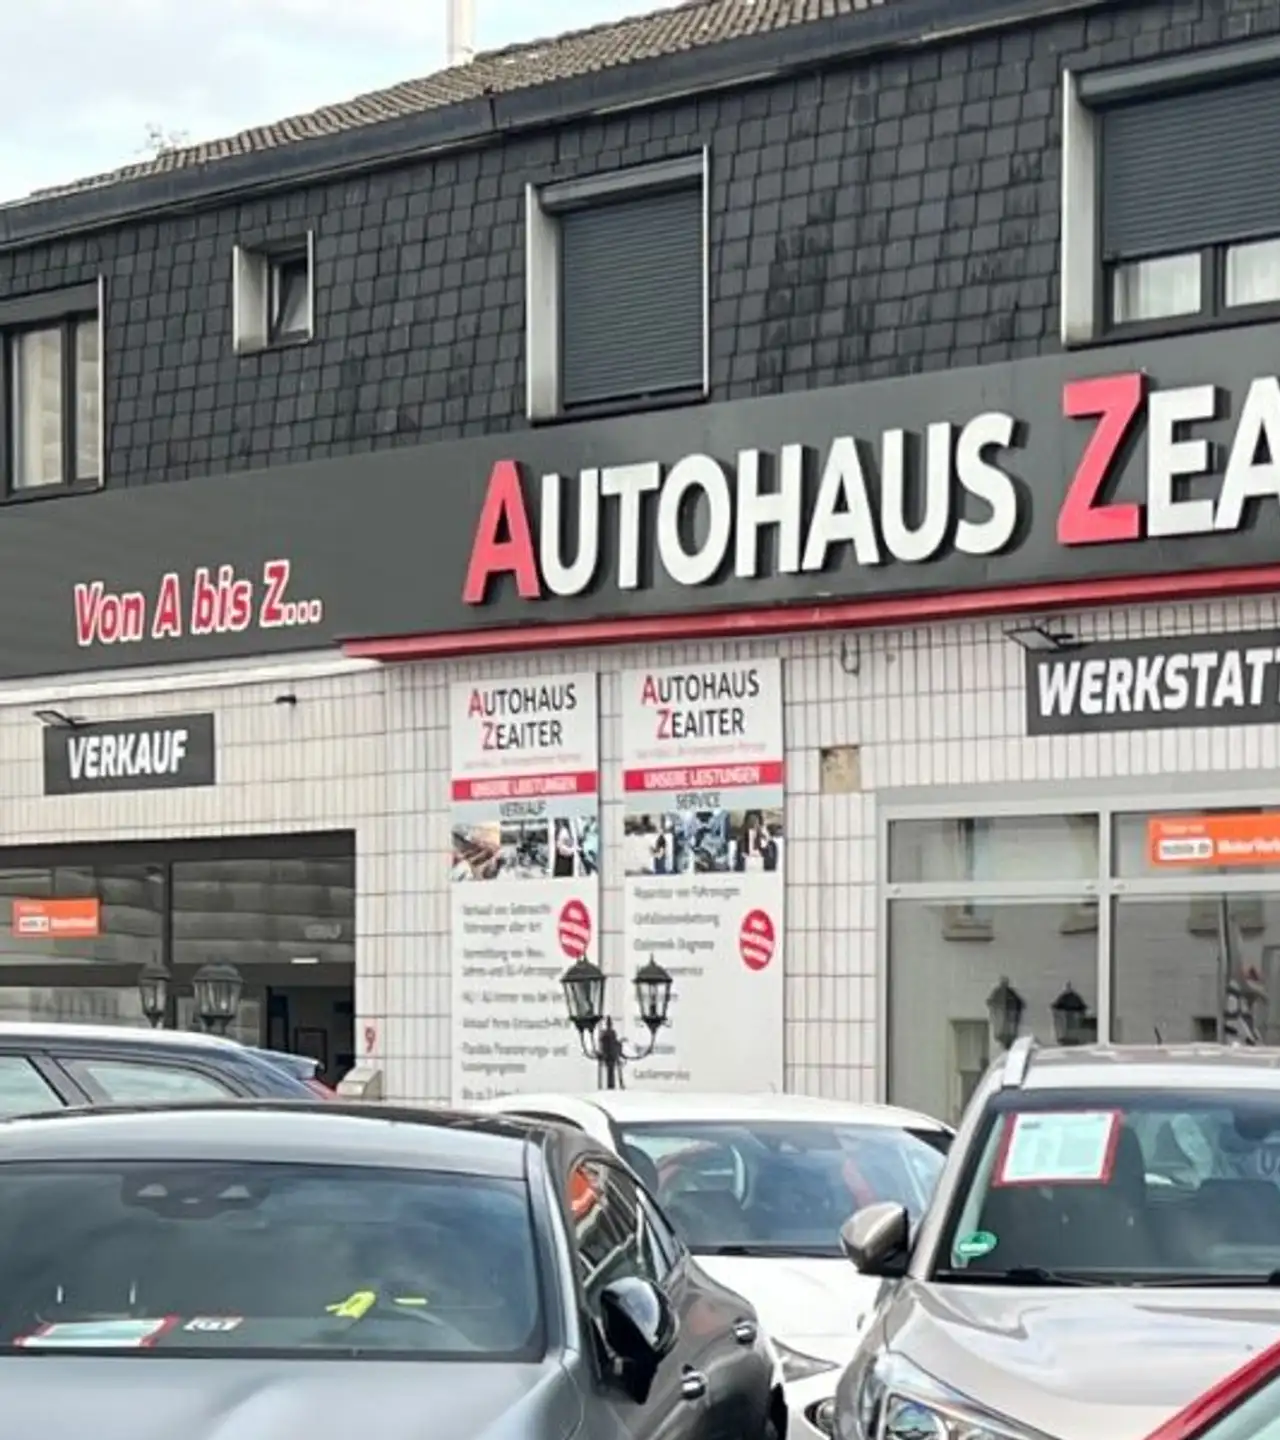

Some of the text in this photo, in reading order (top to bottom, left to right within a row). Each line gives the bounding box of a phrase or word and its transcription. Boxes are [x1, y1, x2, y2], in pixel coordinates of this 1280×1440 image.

[462, 412, 1018, 605] AUTOHAUS
[74, 560, 321, 646] Von A bis Z...
[468, 684, 577, 718] AUTOHAUS
[642, 669, 760, 705] AUTOHAUS
[482, 720, 563, 750] ZEAITER
[656, 708, 745, 739] ZEAITER
[68, 730, 188, 779] VERKAUF
